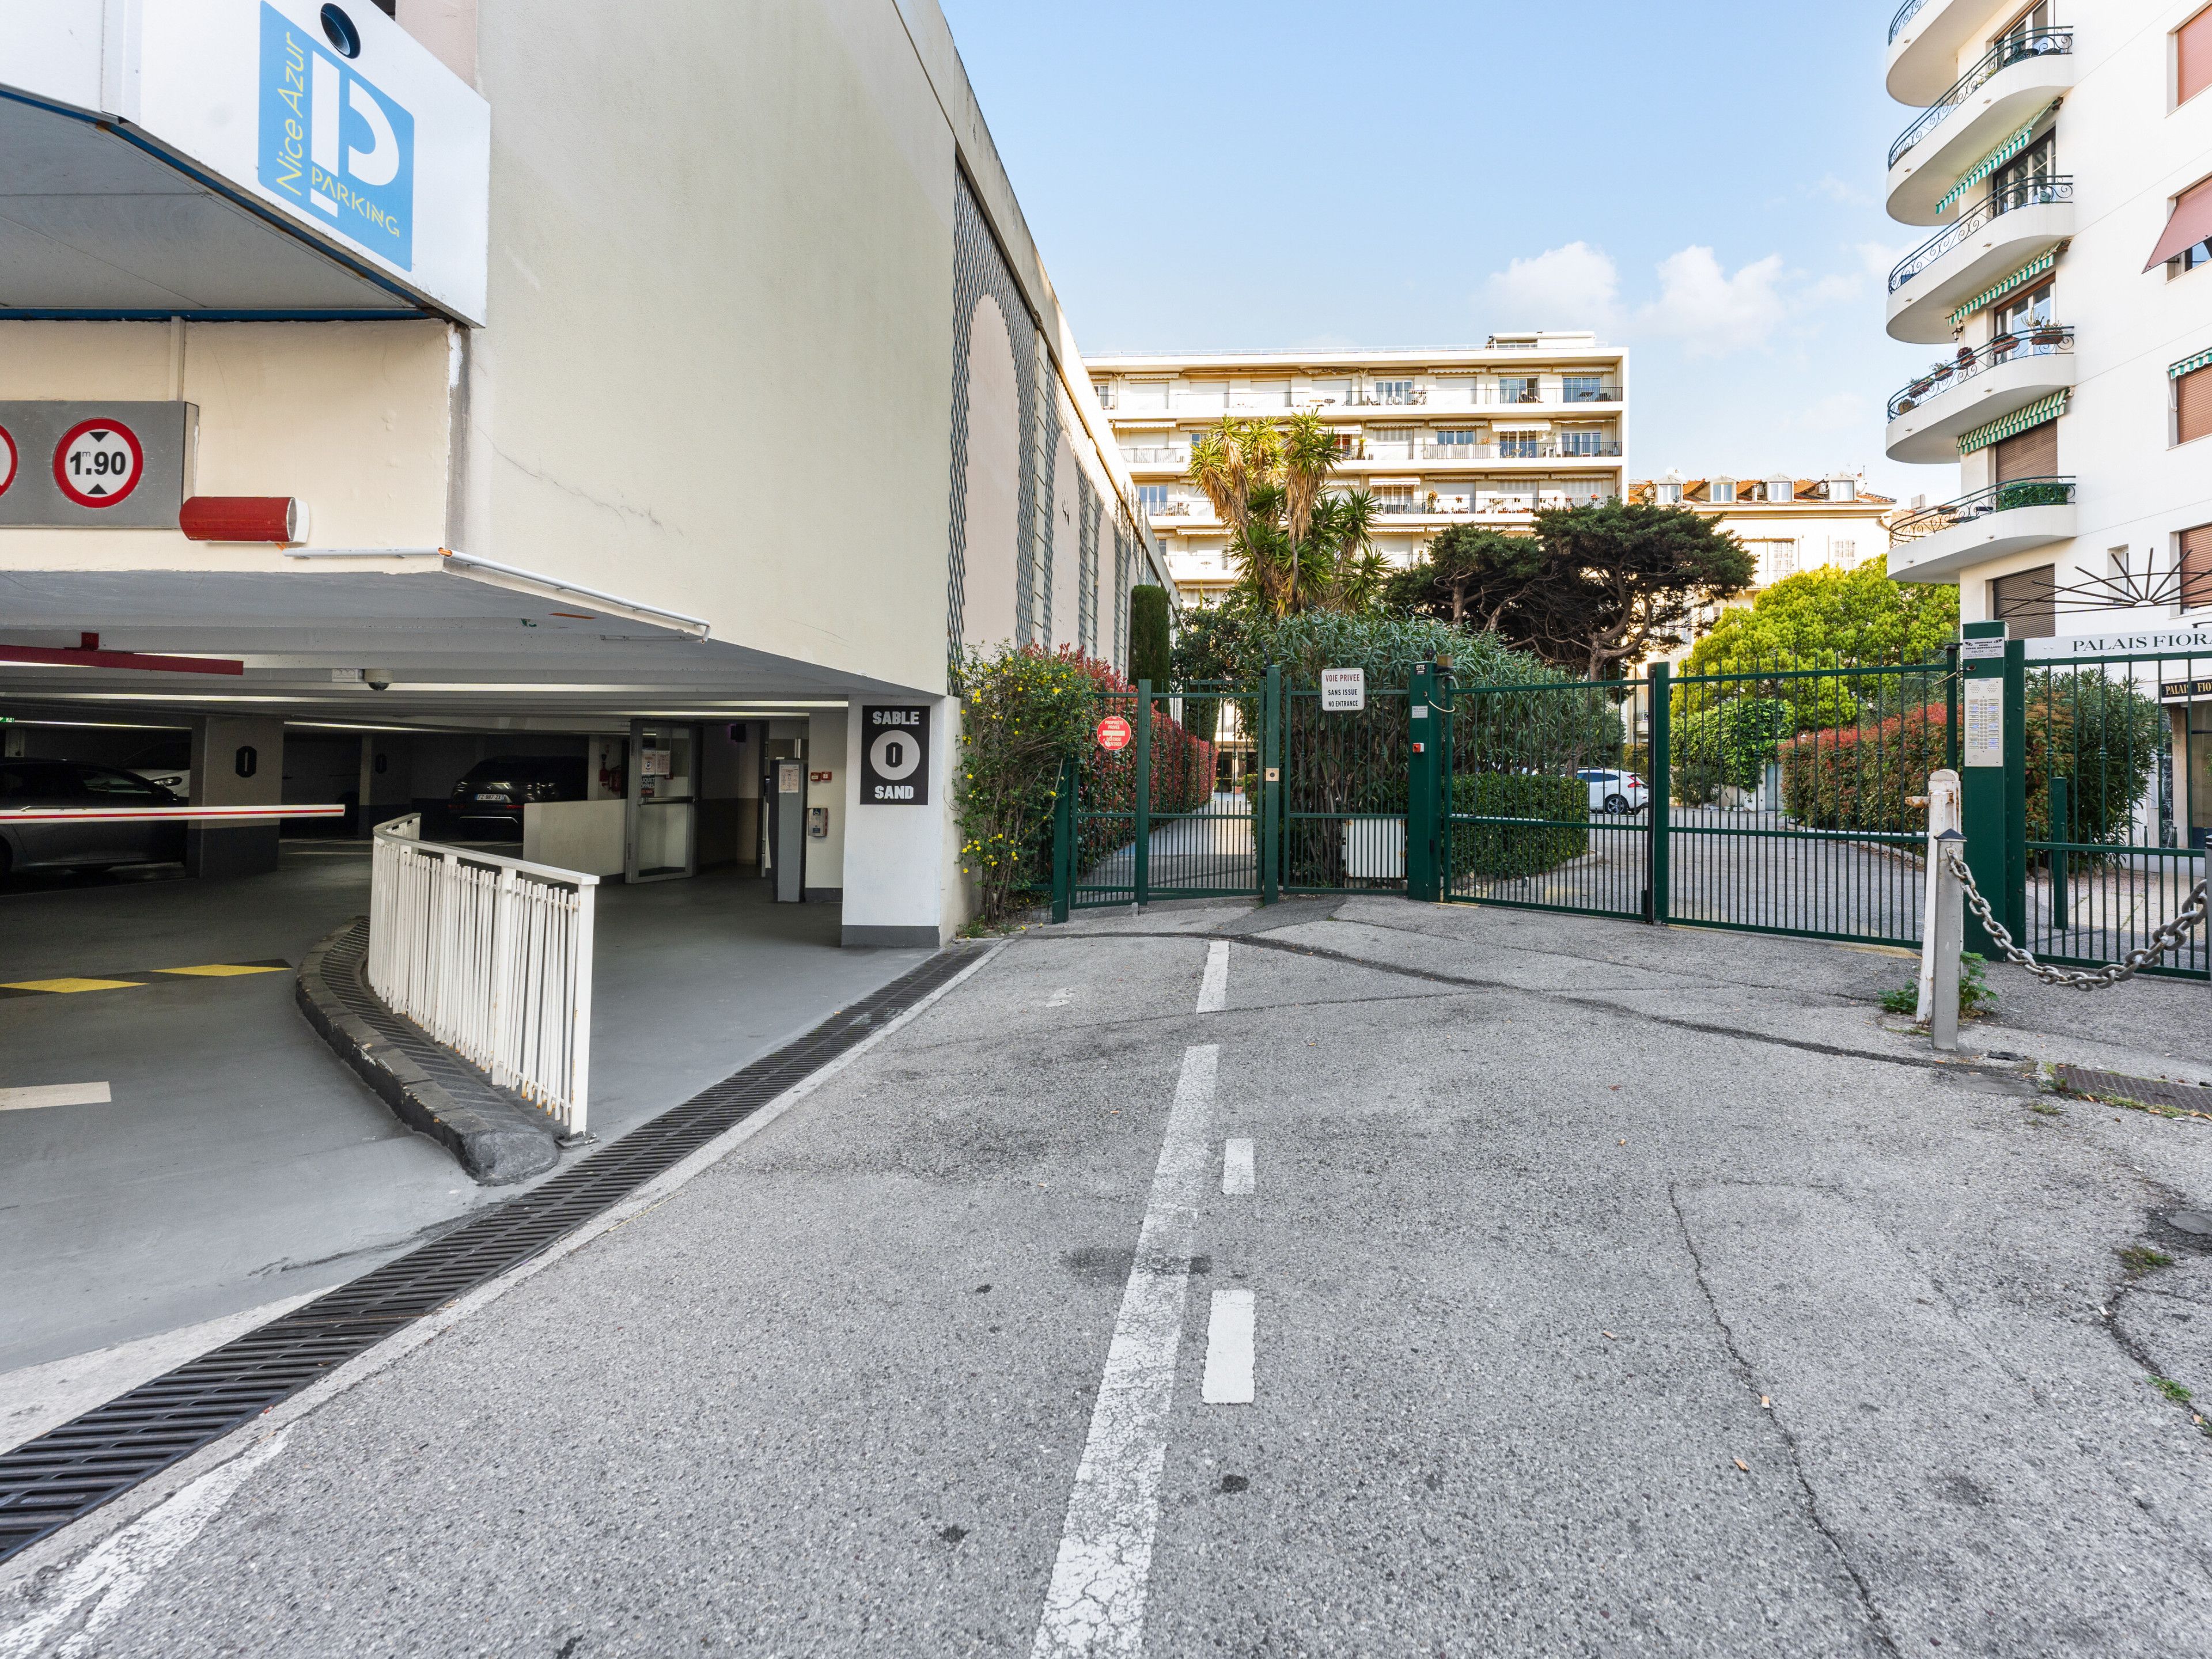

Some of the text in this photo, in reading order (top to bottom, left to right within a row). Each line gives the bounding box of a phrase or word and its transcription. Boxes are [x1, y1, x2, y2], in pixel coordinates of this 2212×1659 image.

[276, 31, 304, 196] Nice Azur
[311, 165, 400, 238] PARKING
[2072, 633, 2212, 652] PALAIS FIOR
[1325, 673, 1360, 682] VOIE PRIVEE
[2165, 681, 2212, 695] PALAI FIO
[873, 711, 919, 725] SABLE
[874, 785, 914, 800] SAND
